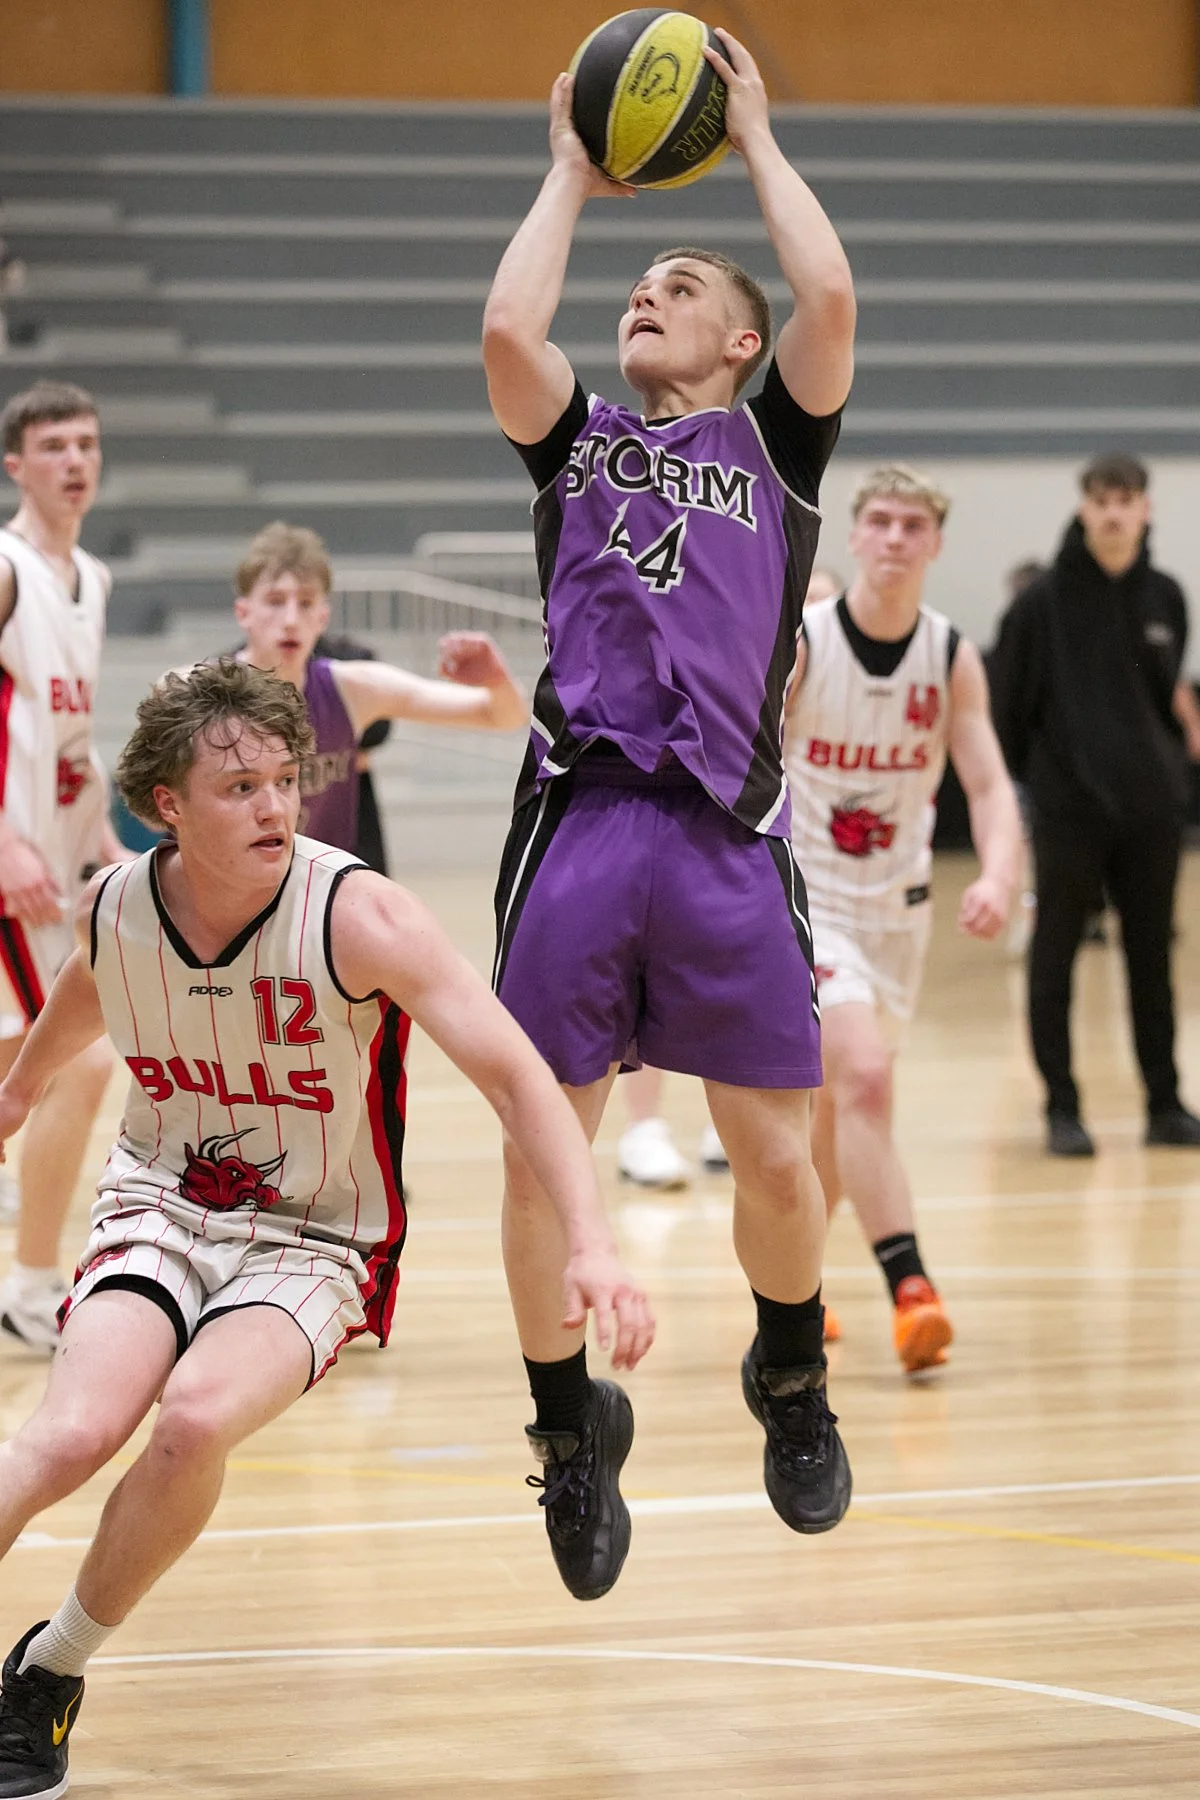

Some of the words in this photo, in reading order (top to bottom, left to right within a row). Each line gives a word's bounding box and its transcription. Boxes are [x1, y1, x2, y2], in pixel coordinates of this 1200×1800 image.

[565, 432, 759, 533] STORM
[807, 738, 927, 773] BULLS
[250, 976, 325, 1046] 12
[125, 1055, 334, 1114] BULLS
